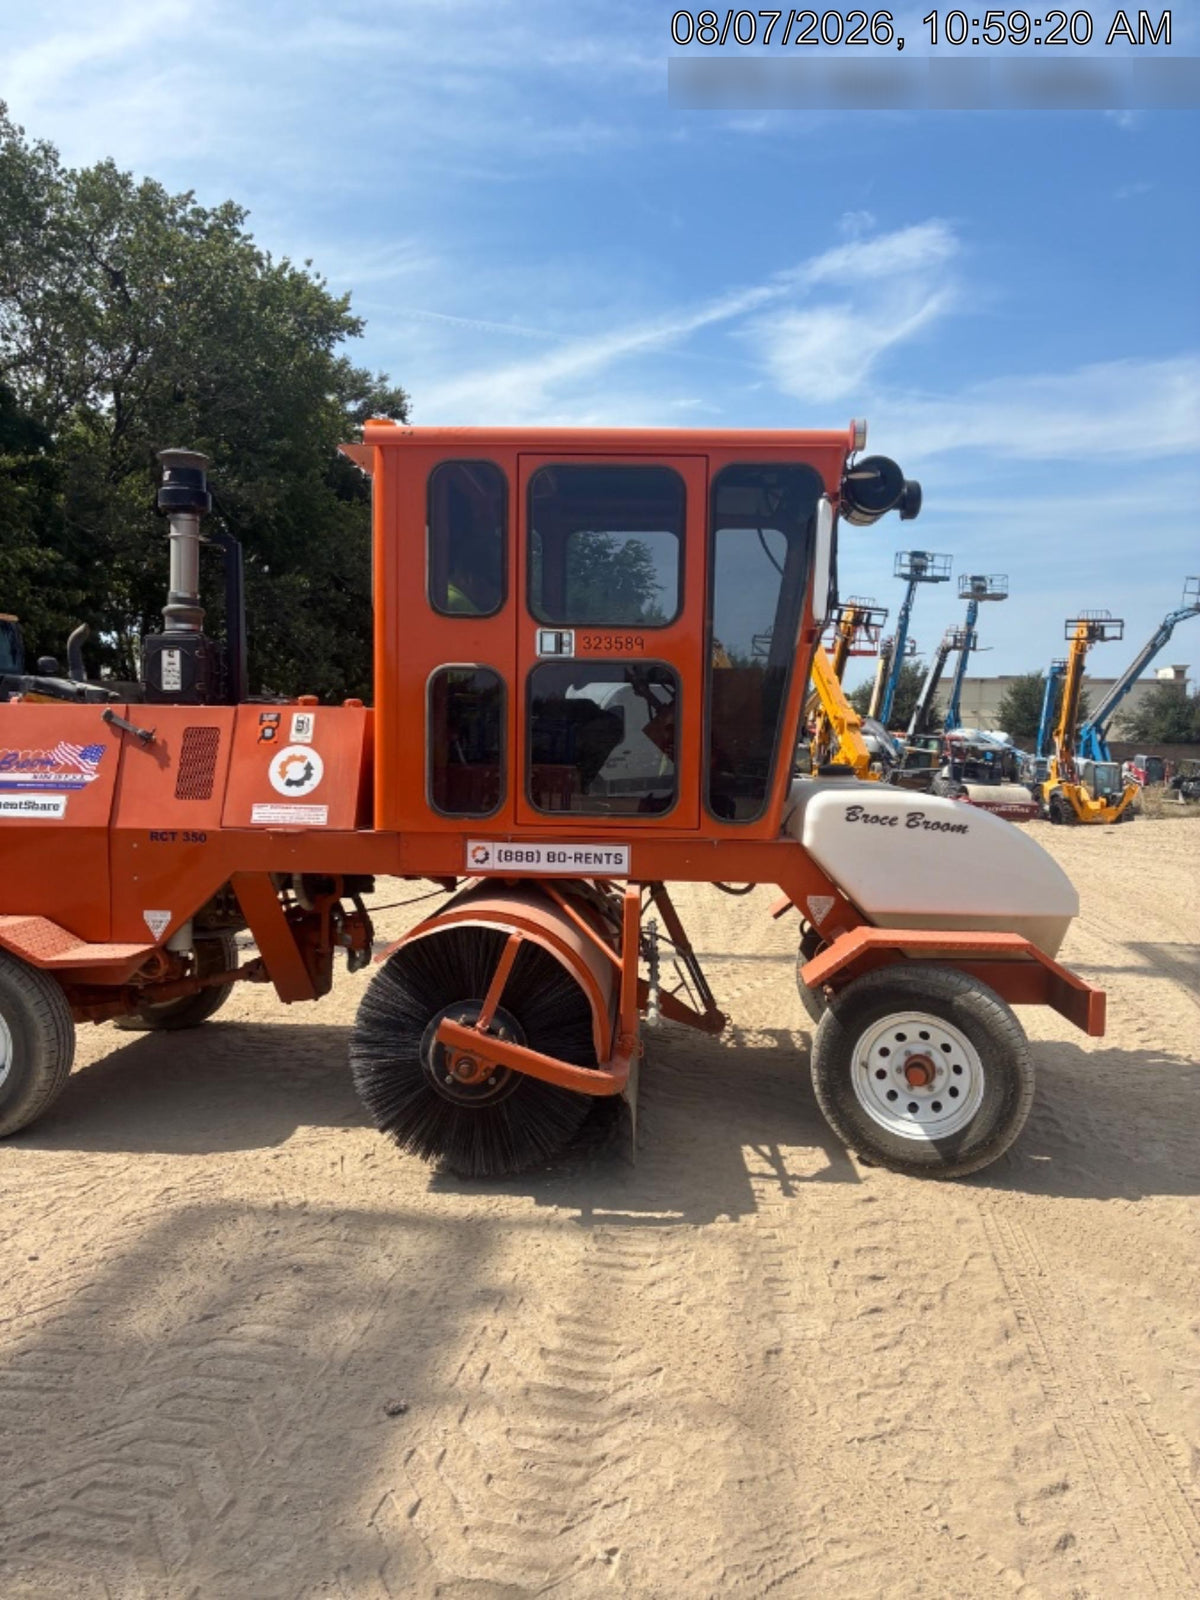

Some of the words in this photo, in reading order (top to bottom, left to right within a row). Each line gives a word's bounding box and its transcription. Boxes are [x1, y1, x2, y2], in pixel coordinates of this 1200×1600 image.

[582, 636, 645, 650] 323589
[845, 805, 899, 826] Broce
[905, 811, 969, 834] Broom
[150, 831, 178, 842] RCT
[182, 831, 207, 844] 350
[497, 849, 541, 863] (888)
